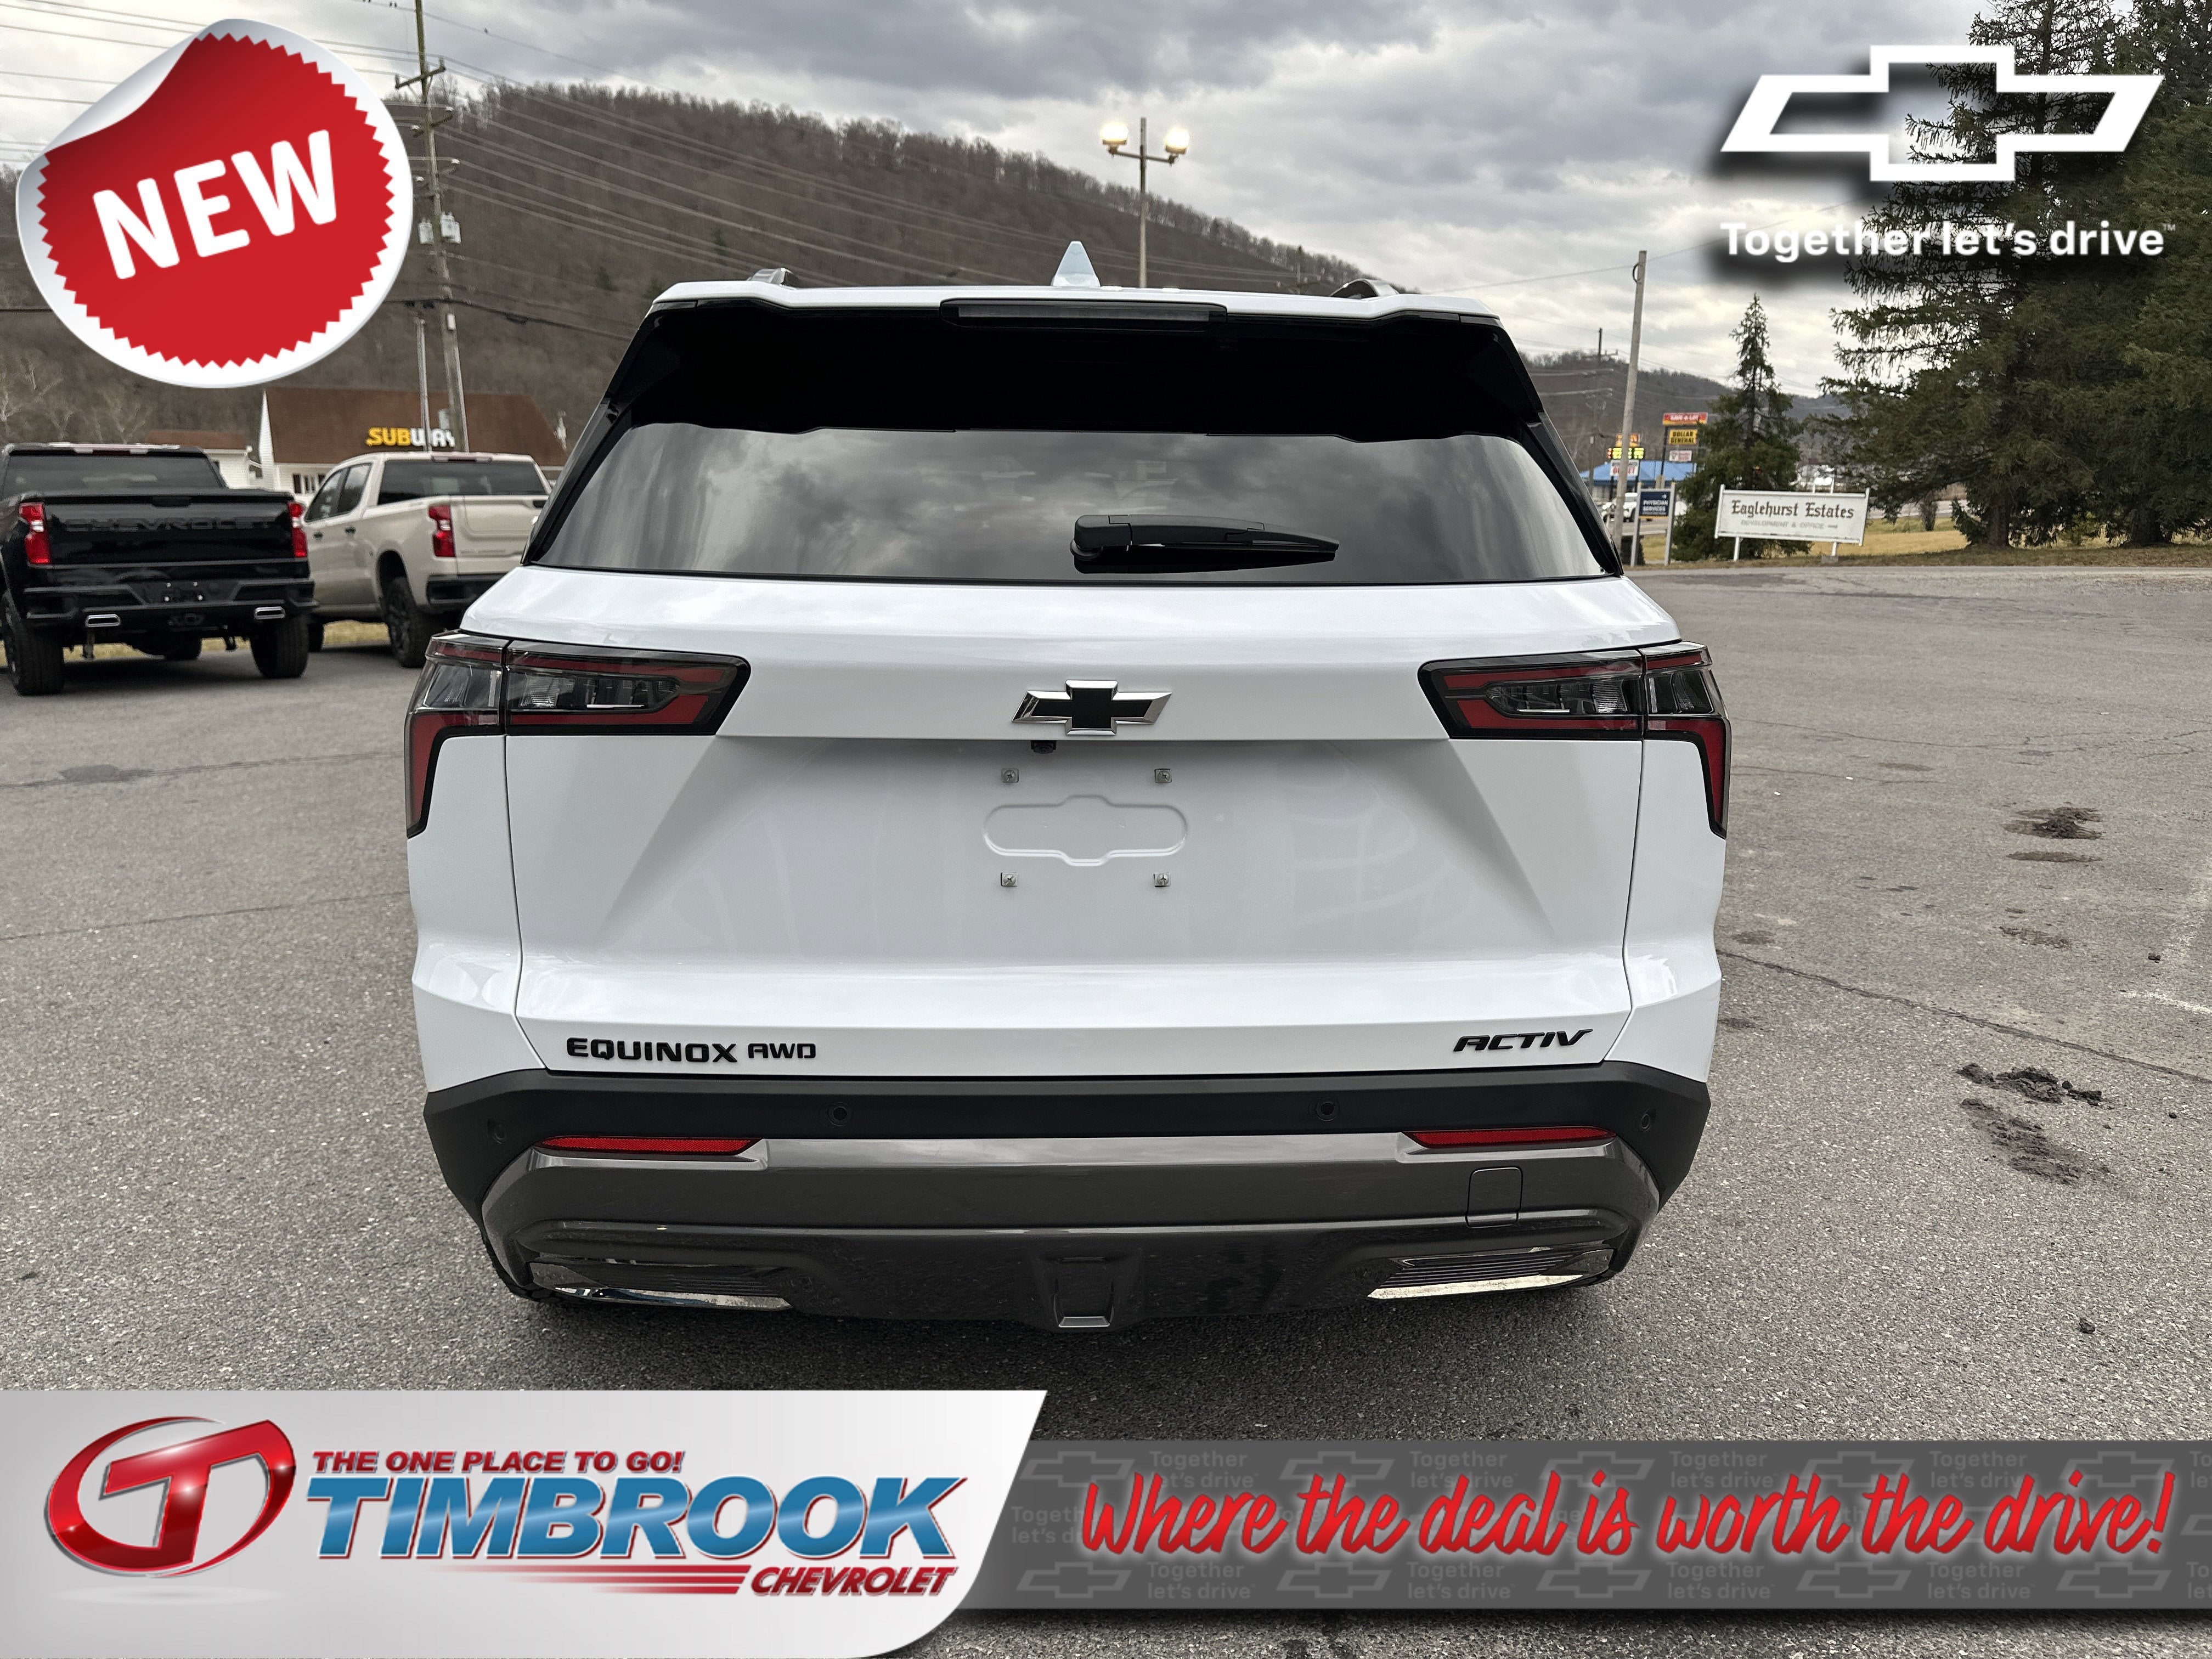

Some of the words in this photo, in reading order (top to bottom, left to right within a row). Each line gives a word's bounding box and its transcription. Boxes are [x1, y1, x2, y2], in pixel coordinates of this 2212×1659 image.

[1731, 499, 1799, 518] Eaglehurst
[1805, 501, 1855, 519] Estates
[566, 1037, 738, 1063] EQUINOX
[748, 1042, 816, 1059] AWD
[1453, 1029, 1593, 1052] ACTIV
